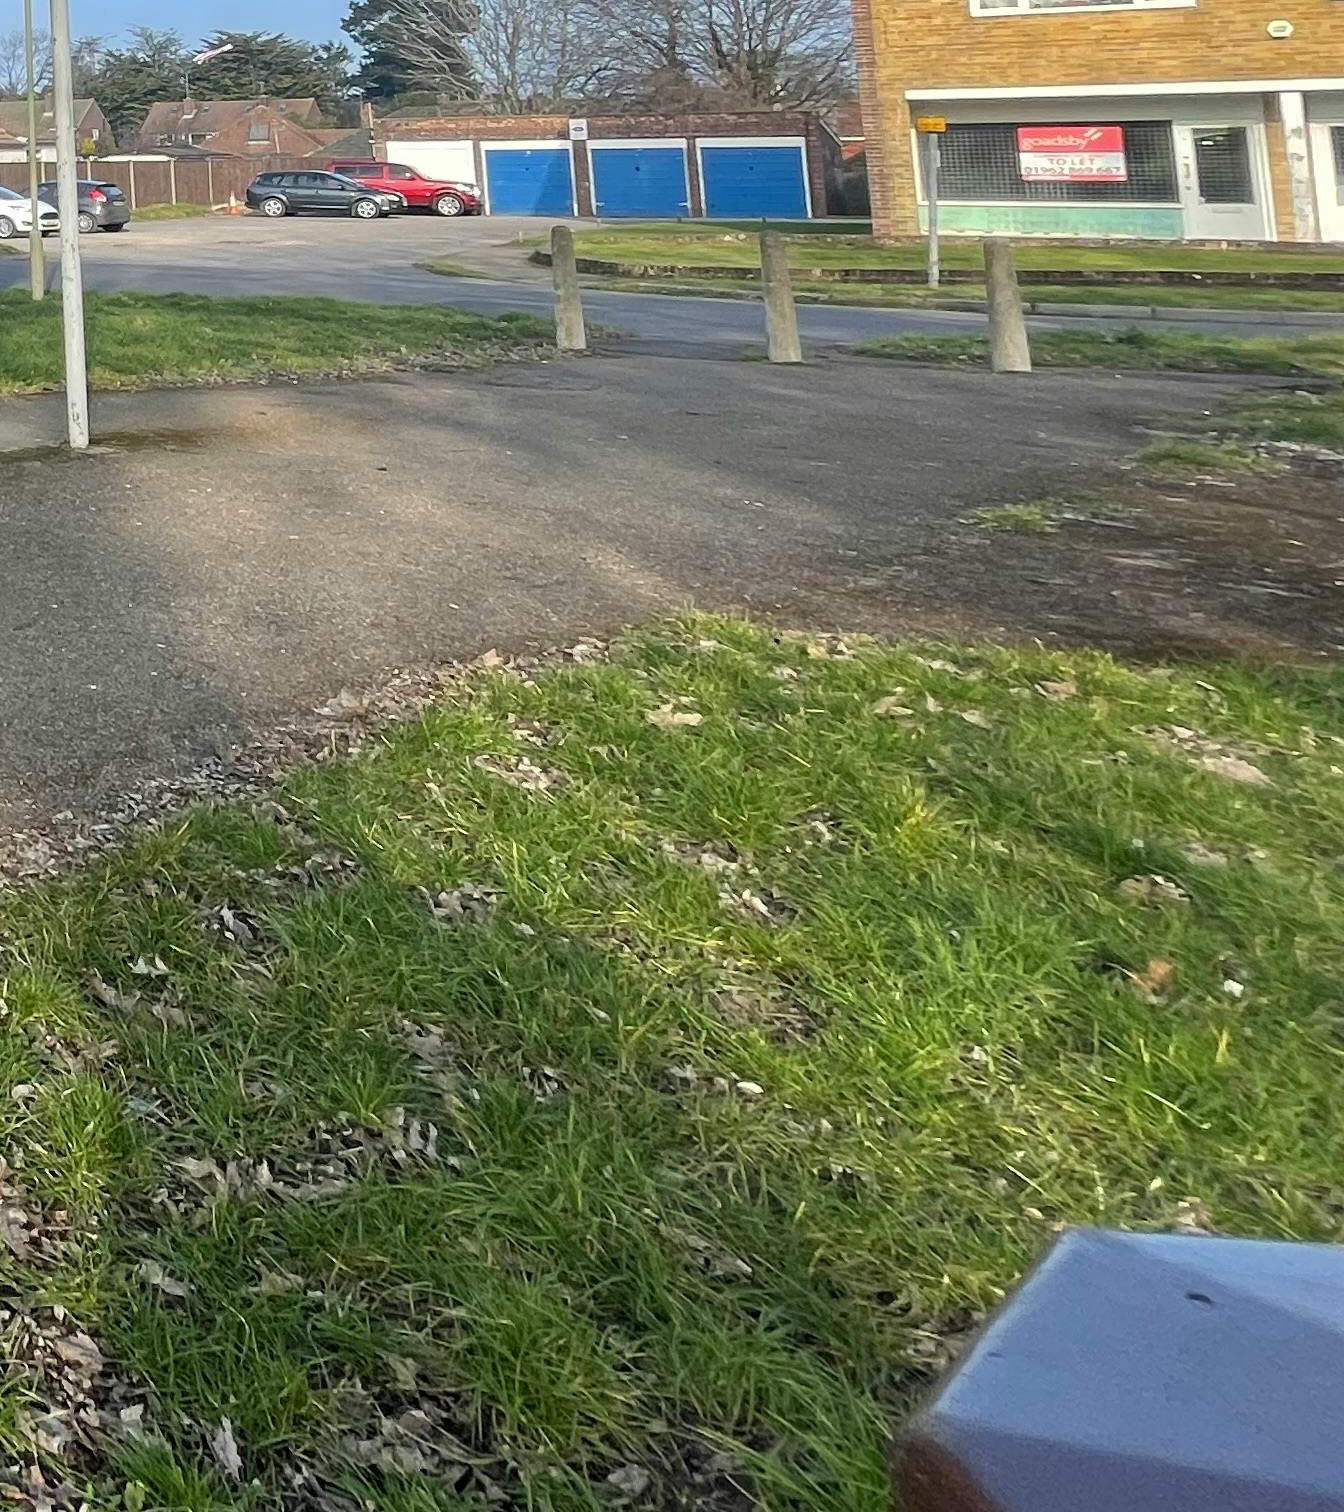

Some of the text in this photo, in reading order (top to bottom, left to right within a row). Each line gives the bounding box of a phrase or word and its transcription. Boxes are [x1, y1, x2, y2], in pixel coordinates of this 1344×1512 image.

[1023, 135, 1089, 151] goadsby
[1047, 158, 1096, 166] TO LET
